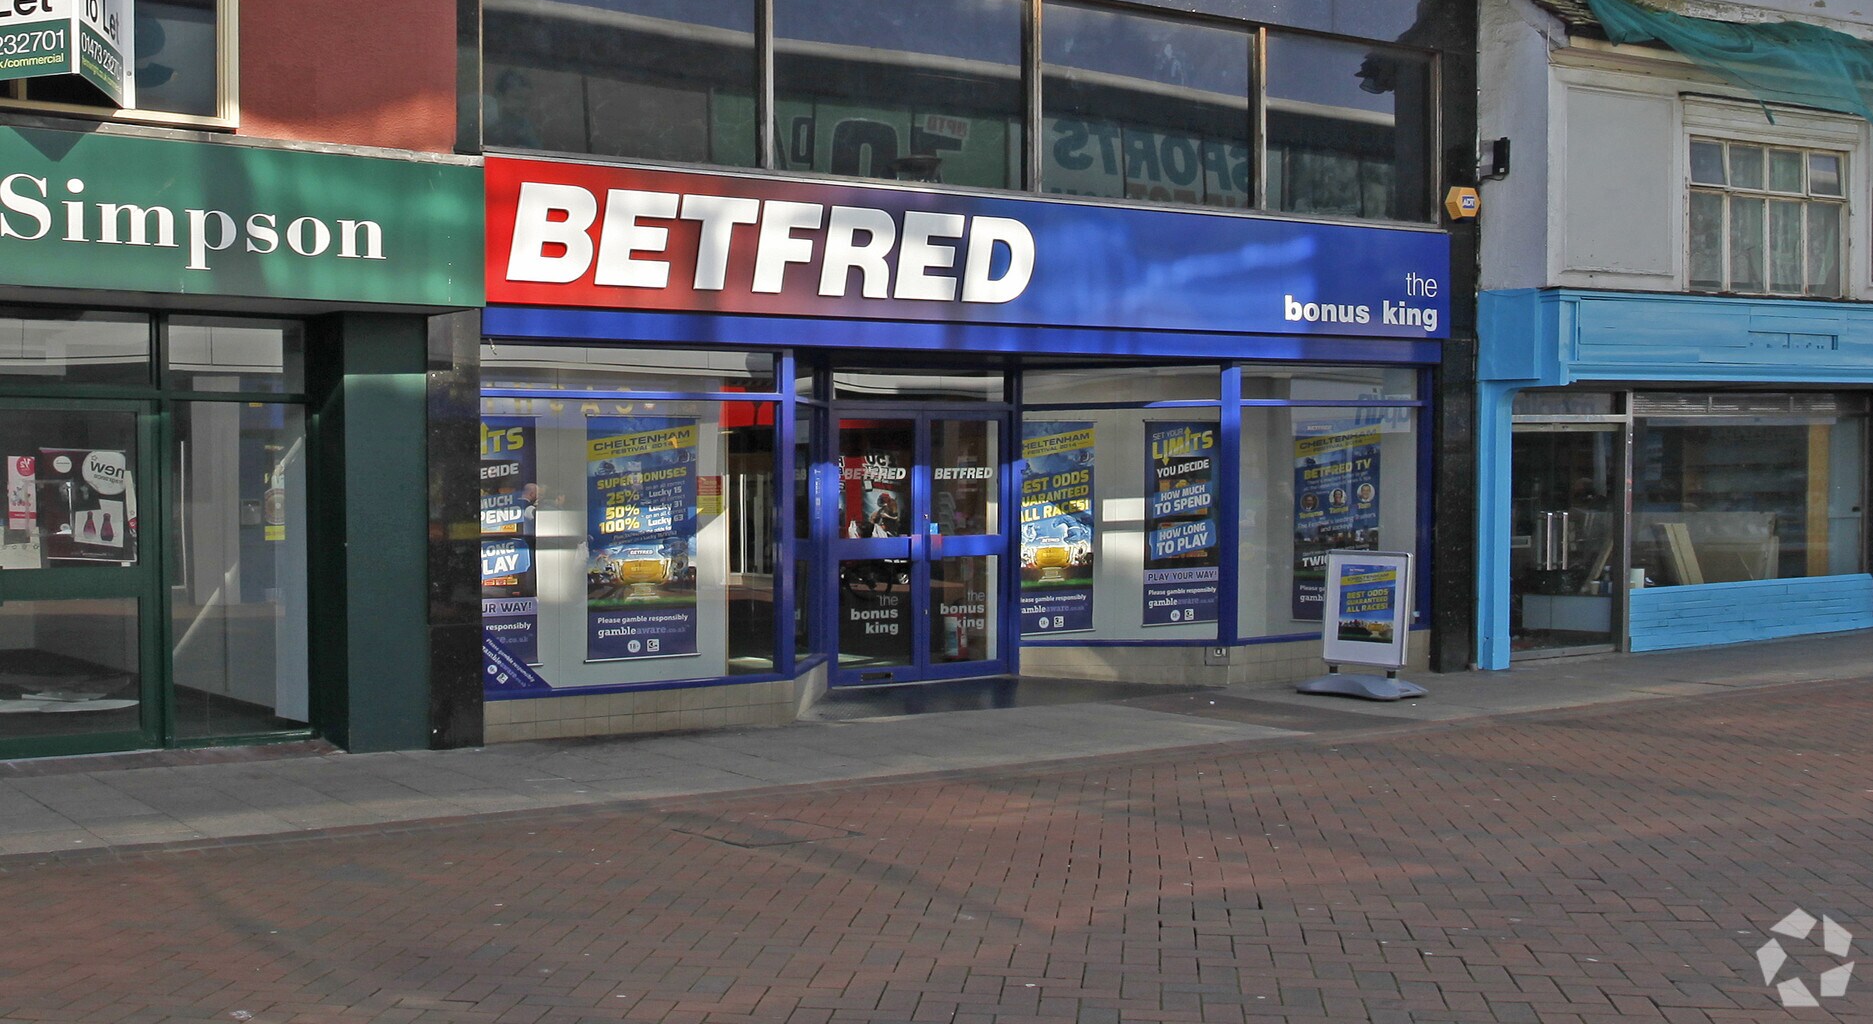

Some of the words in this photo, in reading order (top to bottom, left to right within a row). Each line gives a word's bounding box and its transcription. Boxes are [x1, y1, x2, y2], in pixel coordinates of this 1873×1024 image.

[0, 173, 387, 271] Simpson
[506, 181, 1036, 304] BETFRED
[1406, 272, 1438, 298] the
[1285, 294, 1370, 323] bonus
[1383, 300, 1438, 332] king
[593, 430, 690, 451] CHELTENHAM
[1152, 432, 1165, 441] SET
[1166, 428, 1184, 437] YOUR
[1152, 427, 1214, 464] LIMITS
[845, 467, 906, 480] BETFRED
[934, 467, 994, 480] BETFRED
[1157, 466, 1177, 478] YOU
[1178, 459, 1210, 475] DECIDE
[1304, 462, 1353, 480] BETFRED
[1355, 458, 1372, 471] TV
[597, 474, 633, 490] SUPER
[637, 467, 687, 484] BONUSES
[1022, 477, 1050, 494] EST
[1052, 469, 1089, 488] ODDS
[1160, 489, 1181, 502] HOW
[1182, 484, 1206, 497] MUCH
[605, 504, 640, 520] 50%
[1043, 499, 1090, 518] RACES!
[1154, 502, 1171, 515] TO
[1174, 493, 1211, 512] SPEND
[599, 517, 640, 534] 100%
[1160, 527, 1181, 541] HOW
[1182, 522, 1206, 536] LONG
[1157, 540, 1174, 556] TO
[1177, 532, 1209, 552] PLAY
[1148, 573, 1170, 581] PLAY
[1172, 571, 1193, 580] YOUR
[879, 594, 898, 606] the
[967, 590, 985, 602] the
[501, 602, 532, 613] WAY!
[850, 608, 898, 621] bonus
[940, 603, 985, 615] bonus
[486, 622, 531, 631] responsibly
[622, 616, 647, 625] gamble
[648, 613, 689, 622] responsibly
[955, 617, 985, 629] king
[865, 623, 899, 635] king
